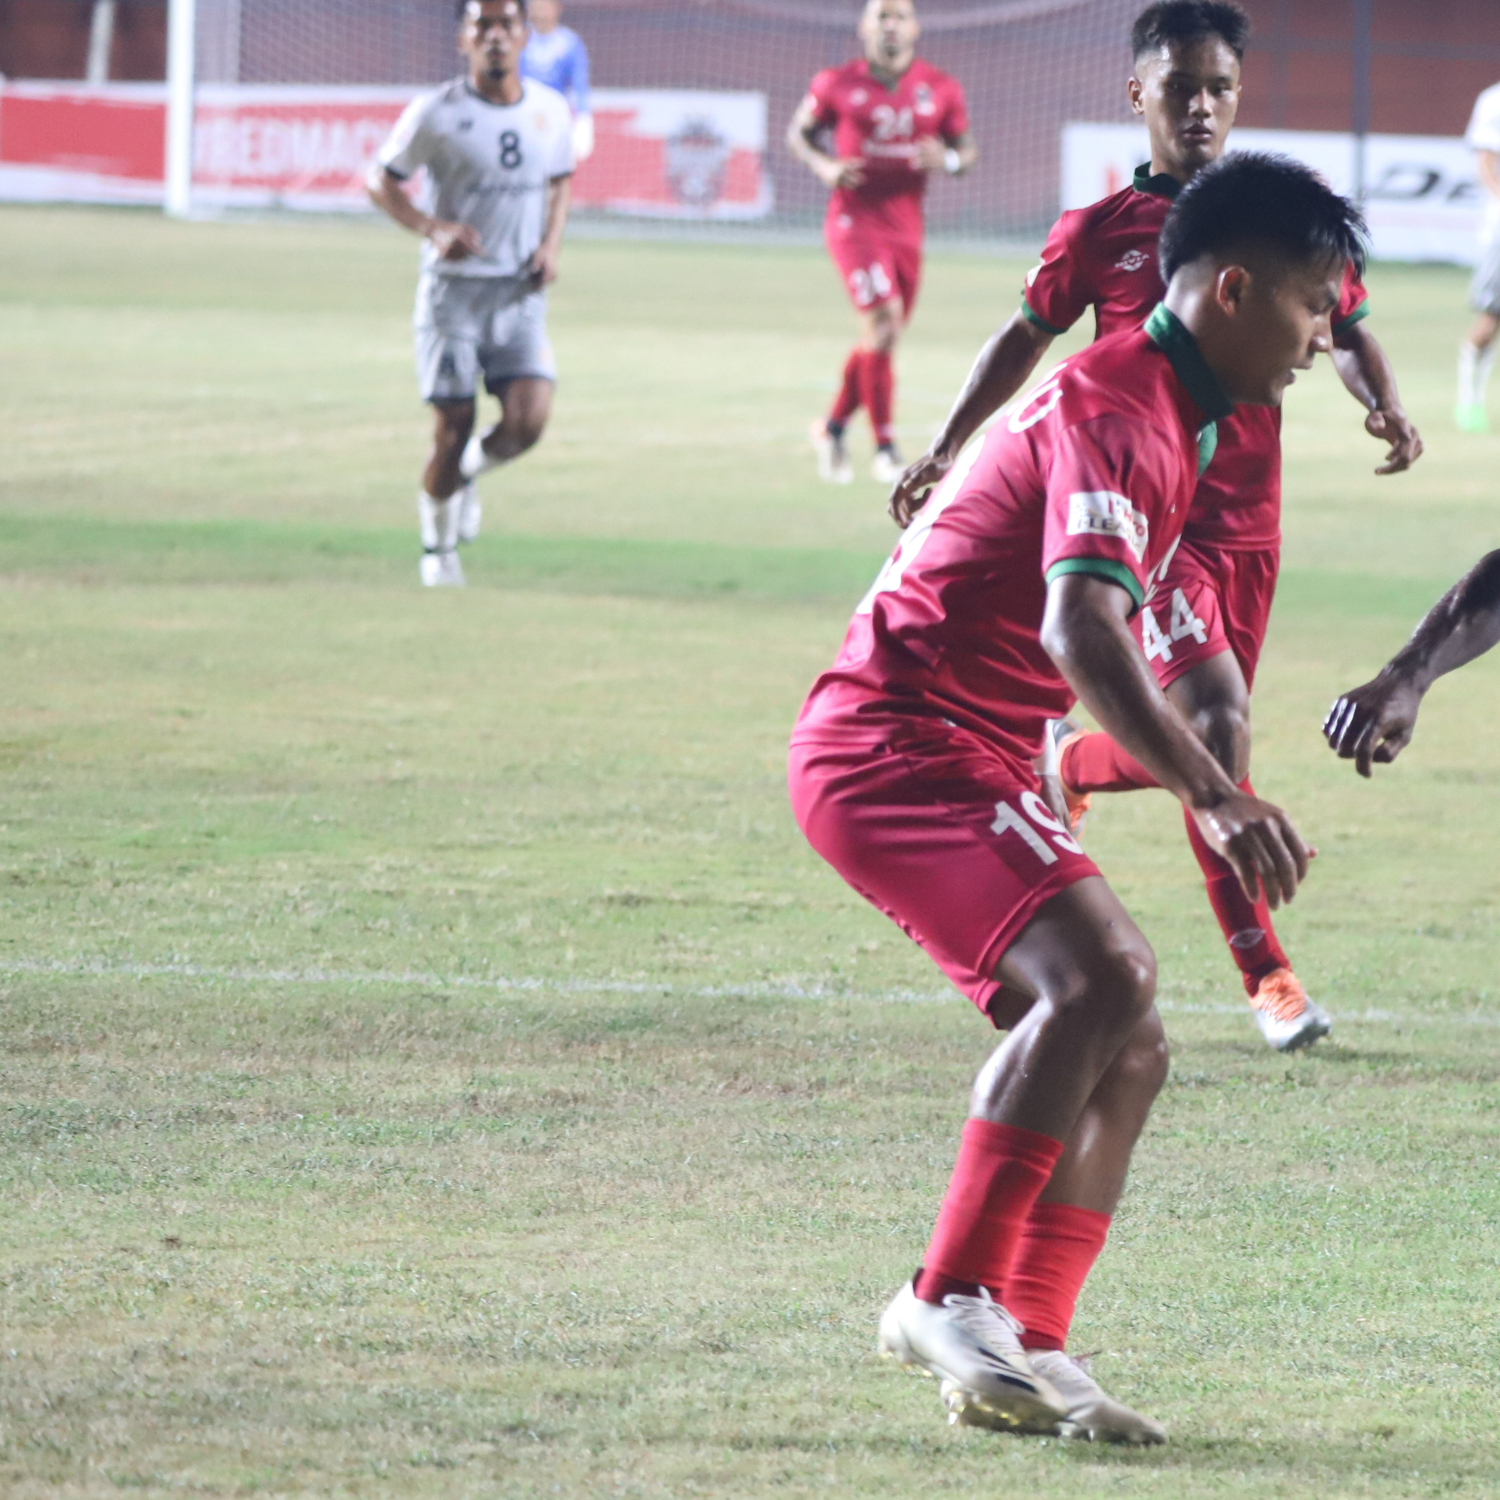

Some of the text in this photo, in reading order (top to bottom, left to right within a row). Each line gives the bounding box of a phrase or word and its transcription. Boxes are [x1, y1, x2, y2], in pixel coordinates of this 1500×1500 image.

[500, 130, 523, 170] 8
[1142, 587, 1208, 663] 44
[990, 790, 1084, 866] 19
